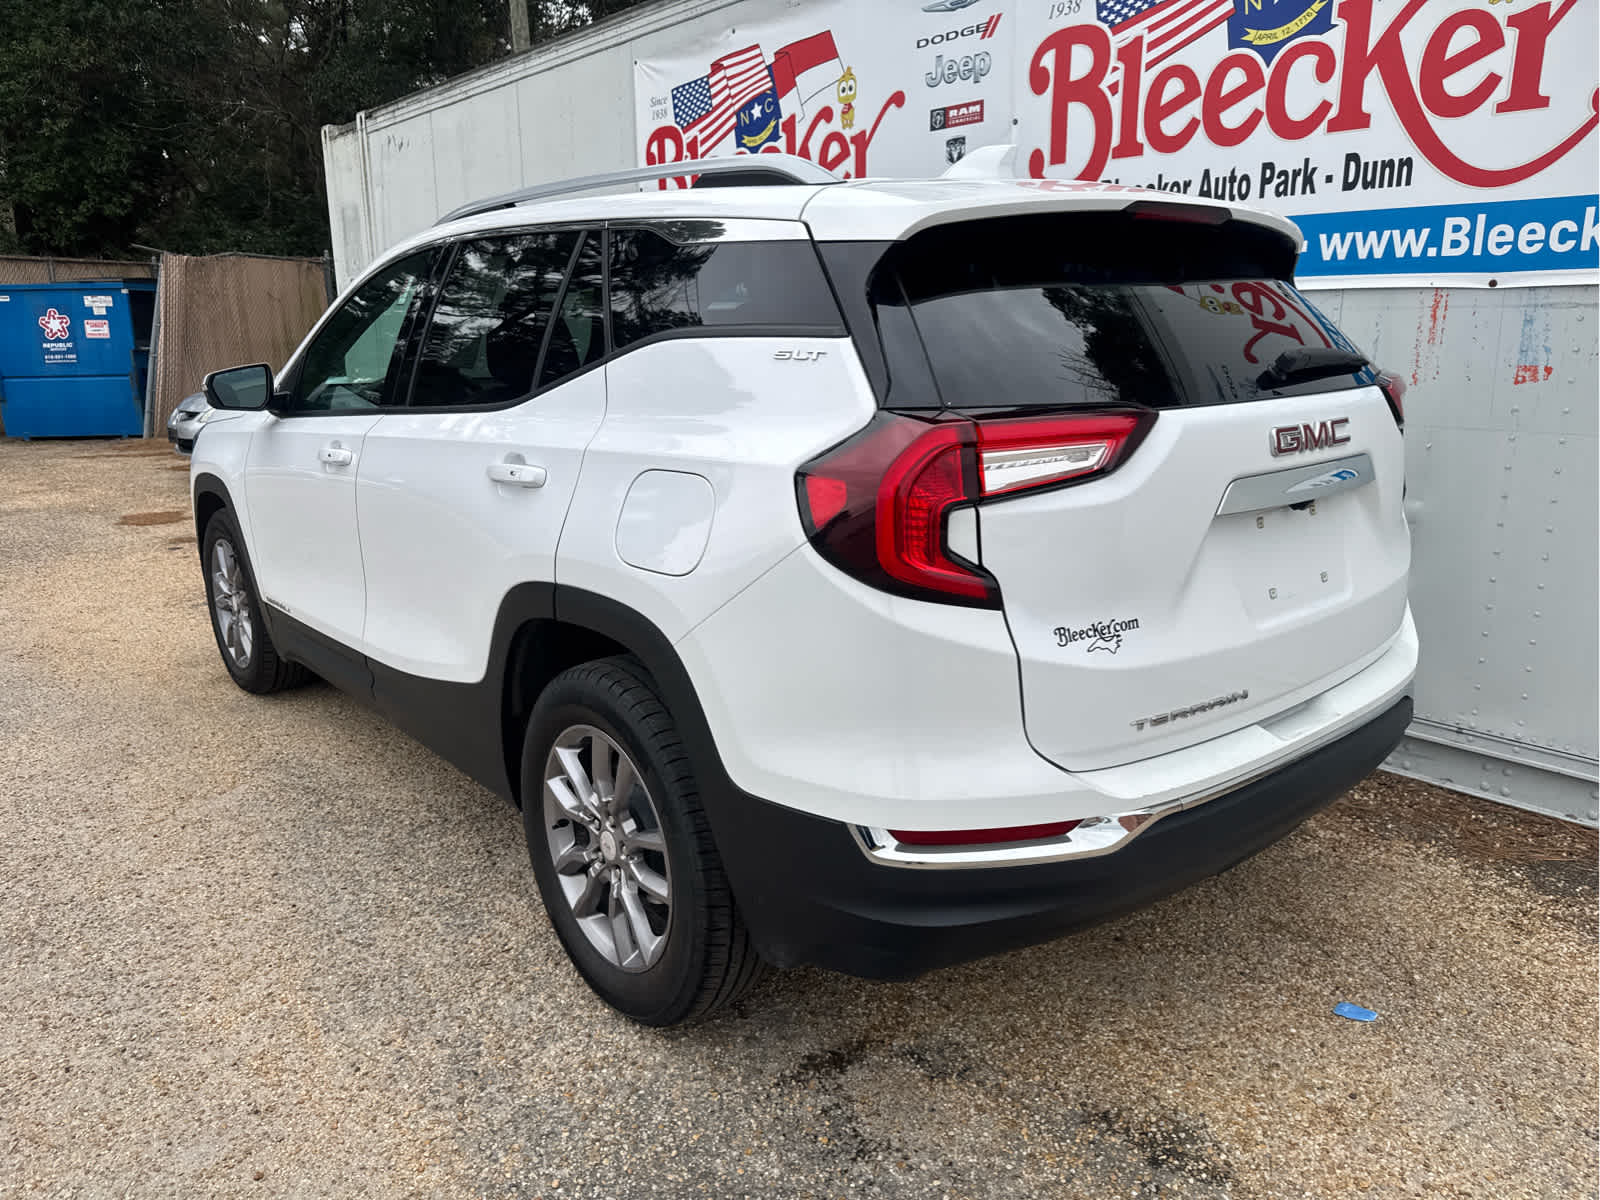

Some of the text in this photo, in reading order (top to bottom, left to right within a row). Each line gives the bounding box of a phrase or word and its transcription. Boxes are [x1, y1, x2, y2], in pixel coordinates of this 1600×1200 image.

[1048, 0, 1082, 20] 1938
[916, 21, 989, 49] DODGE
[925, 51, 992, 88] Jeep
[740, 98, 774, 126] N C
[949, 104, 981, 118] RAM
[1199, 168, 1250, 201] Auto
[1259, 158, 1318, 199] Park
[1341, 152, 1414, 192] Dunn
[772, 350, 828, 361] SLT
[1269, 417, 1351, 457] GMC
[1129, 689, 1249, 732] TERRAIN
